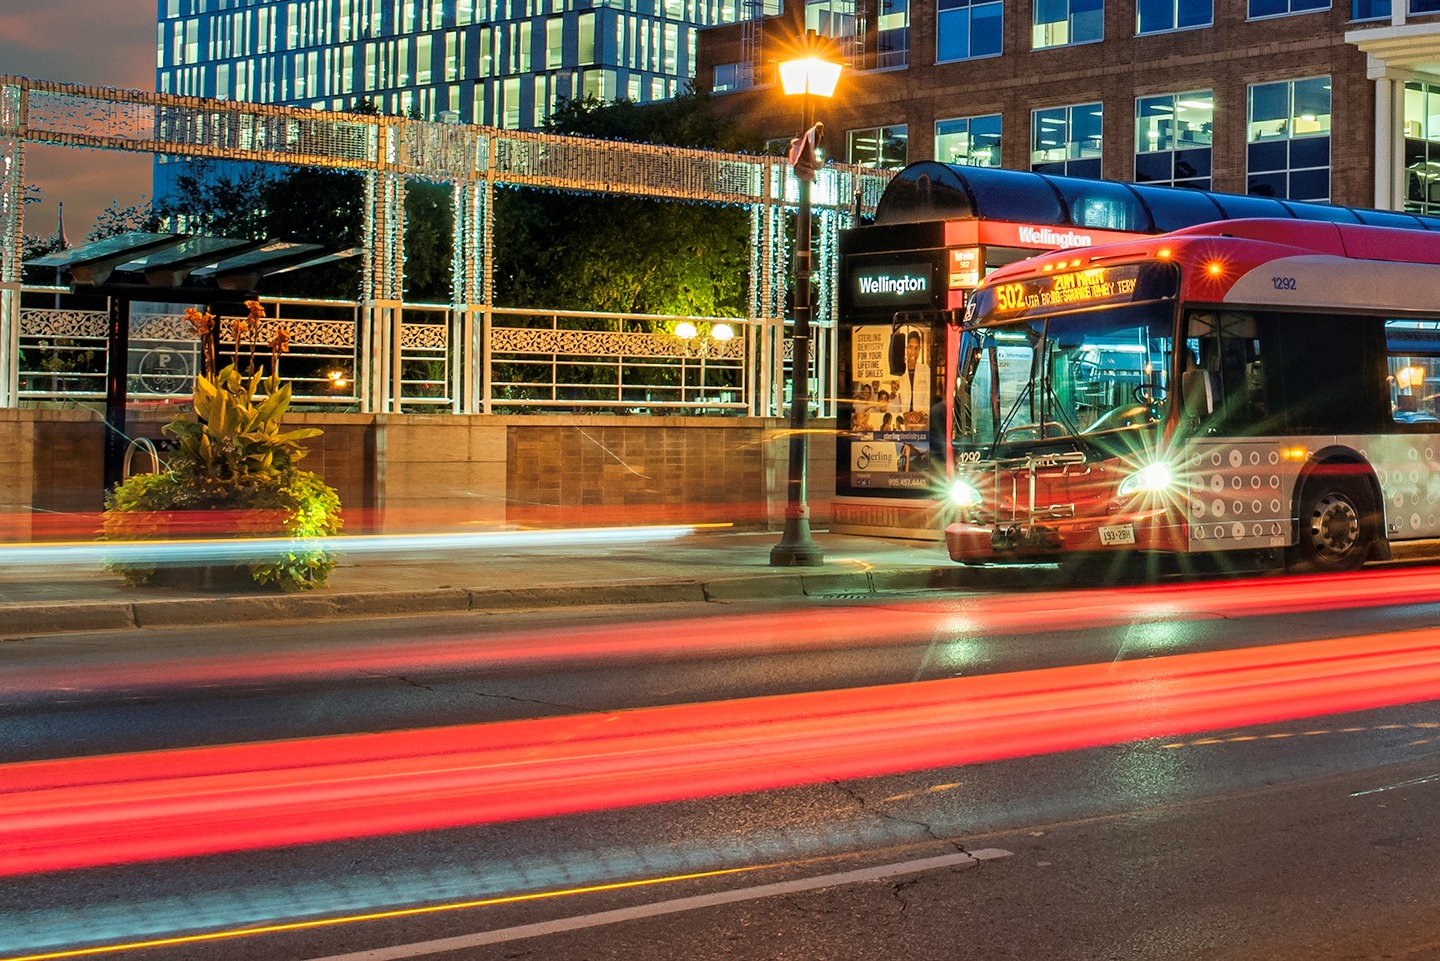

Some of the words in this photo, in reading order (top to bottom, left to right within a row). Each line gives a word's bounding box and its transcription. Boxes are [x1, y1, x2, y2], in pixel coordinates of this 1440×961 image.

[1019, 226, 1092, 248] Wellington
[955, 252, 975, 262] Main
[859, 275, 926, 294] Wellington
[1272, 277, 1297, 290] 1292
[995, 283, 1026, 310] 502
[858, 334, 881, 342] STERLING
[858, 343, 884, 351] DENTISTRY
[858, 352, 867, 360] FOR
[869, 352, 882, 360] YOUR
[858, 361, 879, 369] LIFETIME
[858, 370, 864, 378] OF
[866, 370, 883, 378] SMILES
[857, 445, 893, 469] Sterling
[960, 451, 981, 464] 1292
